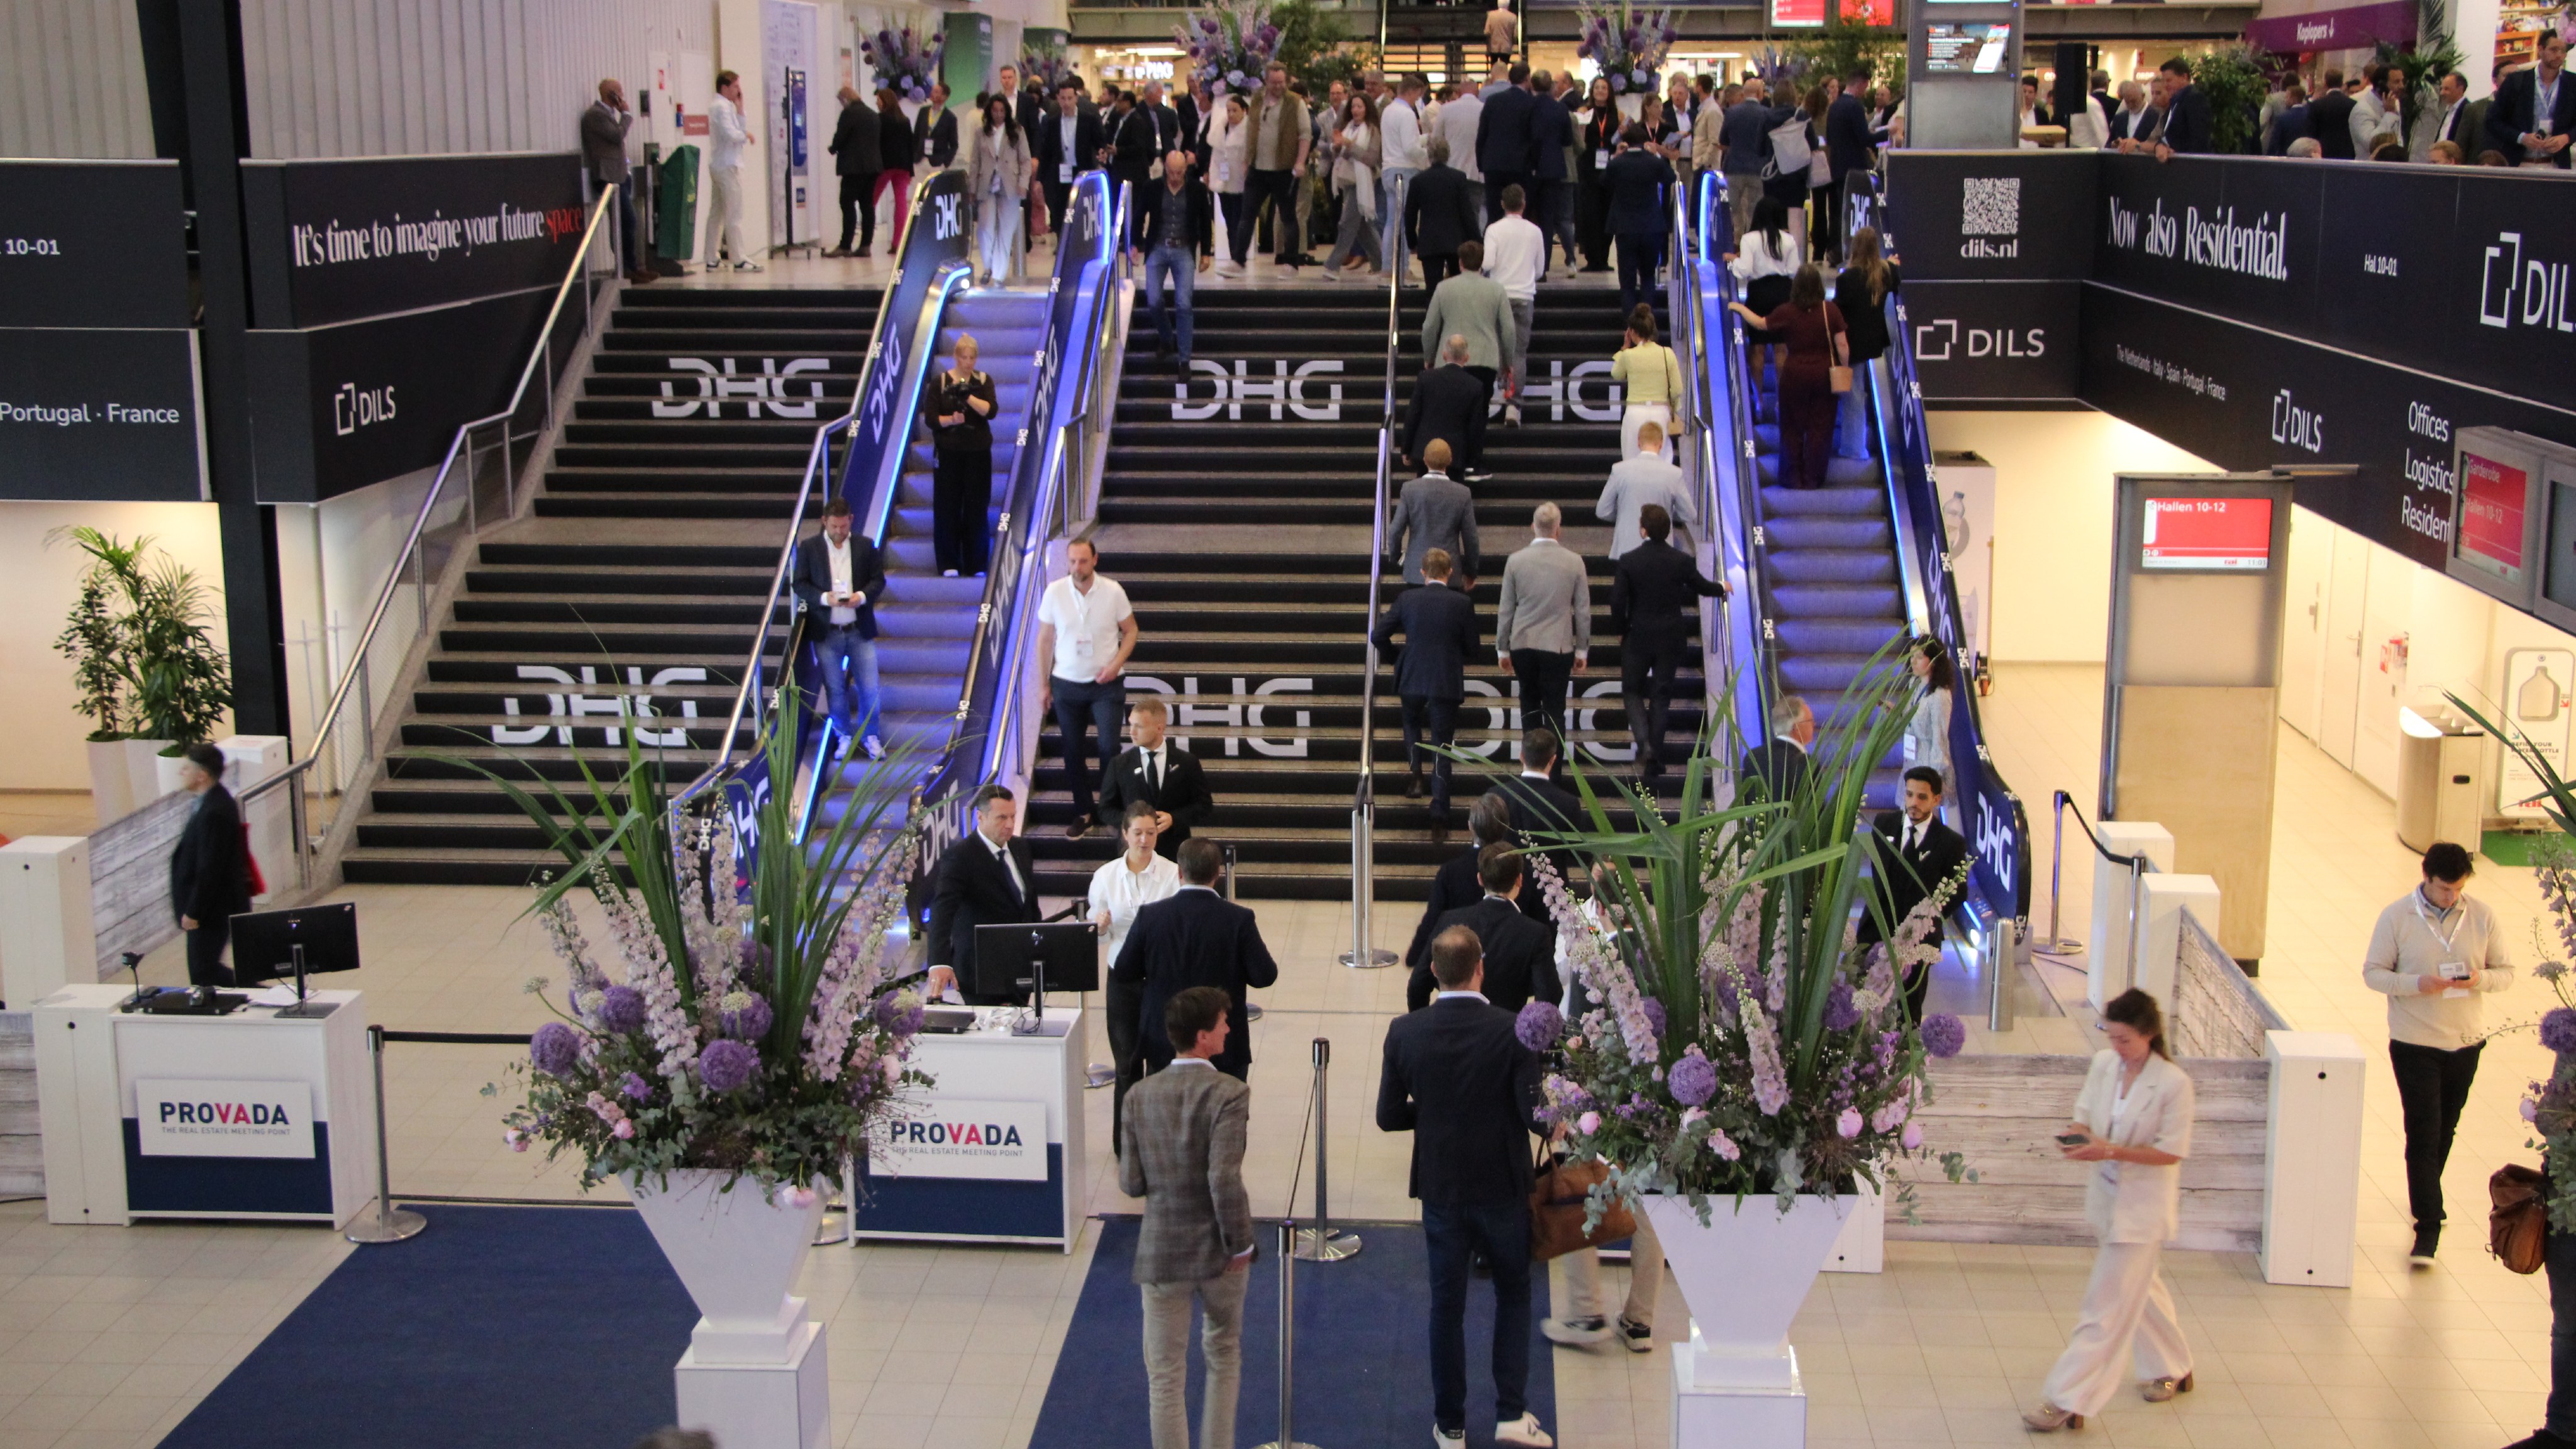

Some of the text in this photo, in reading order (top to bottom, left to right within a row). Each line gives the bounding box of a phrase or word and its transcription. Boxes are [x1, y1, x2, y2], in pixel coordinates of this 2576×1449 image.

[935, 192, 962, 240] DHG
[1083, 193, 1102, 242] DHG
[6, 238, 61, 255] 10-01
[293, 203, 582, 267] It's time to imagine your future space
[1960, 238, 2018, 258] dils.nl
[2107, 196, 2287, 282] Now also Residential.
[2364, 254, 2397, 277] Hal 10-01
[2523, 259, 2576, 333] DIL
[1968, 329, 2045, 357] DILS
[2124, 347, 2151, 373] Netherlands
[2153, 357, 2163, 381] Italy
[2167, 362, 2180, 384] Spain
[2182, 368, 2204, 395] Portugal
[2207, 377, 2226, 401] France
[652, 358, 830, 418] DHG
[1171, 360, 1344, 420] DHG
[0, 402, 180, 427] Portugal France
[359, 385, 396, 426] DILS
[848, 419, 861, 438] DHG
[2290, 406, 2323, 453] DILS
[2408, 401, 2449, 442] Offices
[2404, 448, 2453, 495] Logistics
[2469, 458, 2501, 483] Garderobe
[2157, 502, 2226, 513] Hallen 10-12
[2465, 498, 2503, 524] Hallen 10-12
[1753, 526, 1765, 547] DHG
[1940, 552, 1952, 573] DHG
[979, 602, 991, 624] DHG
[1763, 618, 1775, 640] DHG
[1957, 647, 1970, 669] DHG
[492, 665, 707, 747] DHG
[699, 818, 712, 851] DHG
[1976, 791, 2012, 892] DHG
[160, 1102, 290, 1125] PROVADA
[201, 1127, 228, 1135] ESTATE
[891, 1121, 1023, 1146] PROVADA
